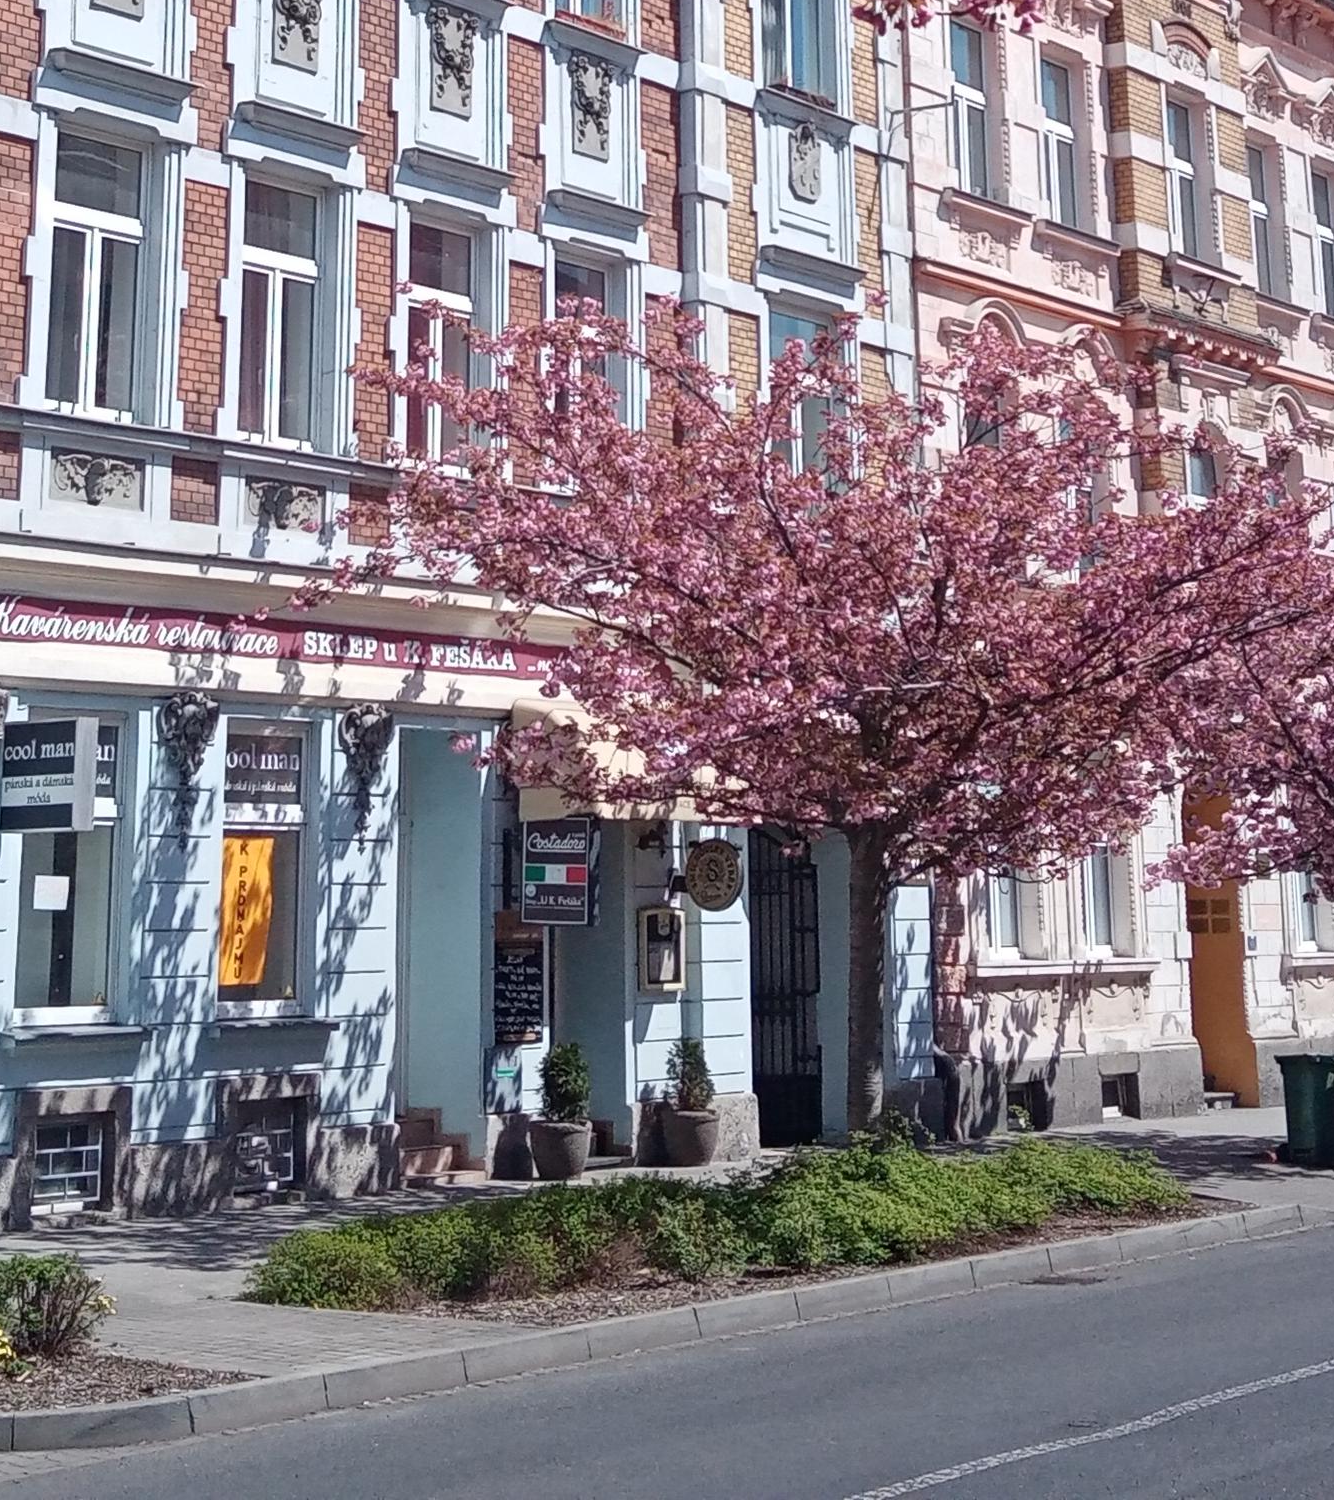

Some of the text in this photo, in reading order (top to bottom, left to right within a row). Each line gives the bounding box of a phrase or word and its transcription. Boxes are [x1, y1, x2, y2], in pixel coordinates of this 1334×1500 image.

[303, 631, 378, 660] SKLEP
[383, 642, 398, 662] u
[4, 739, 75, 761] cool man
[260, 753, 300, 771] man
[527, 832, 586, 853] Costadoro
[233, 842, 249, 979] K PRONAJMU
